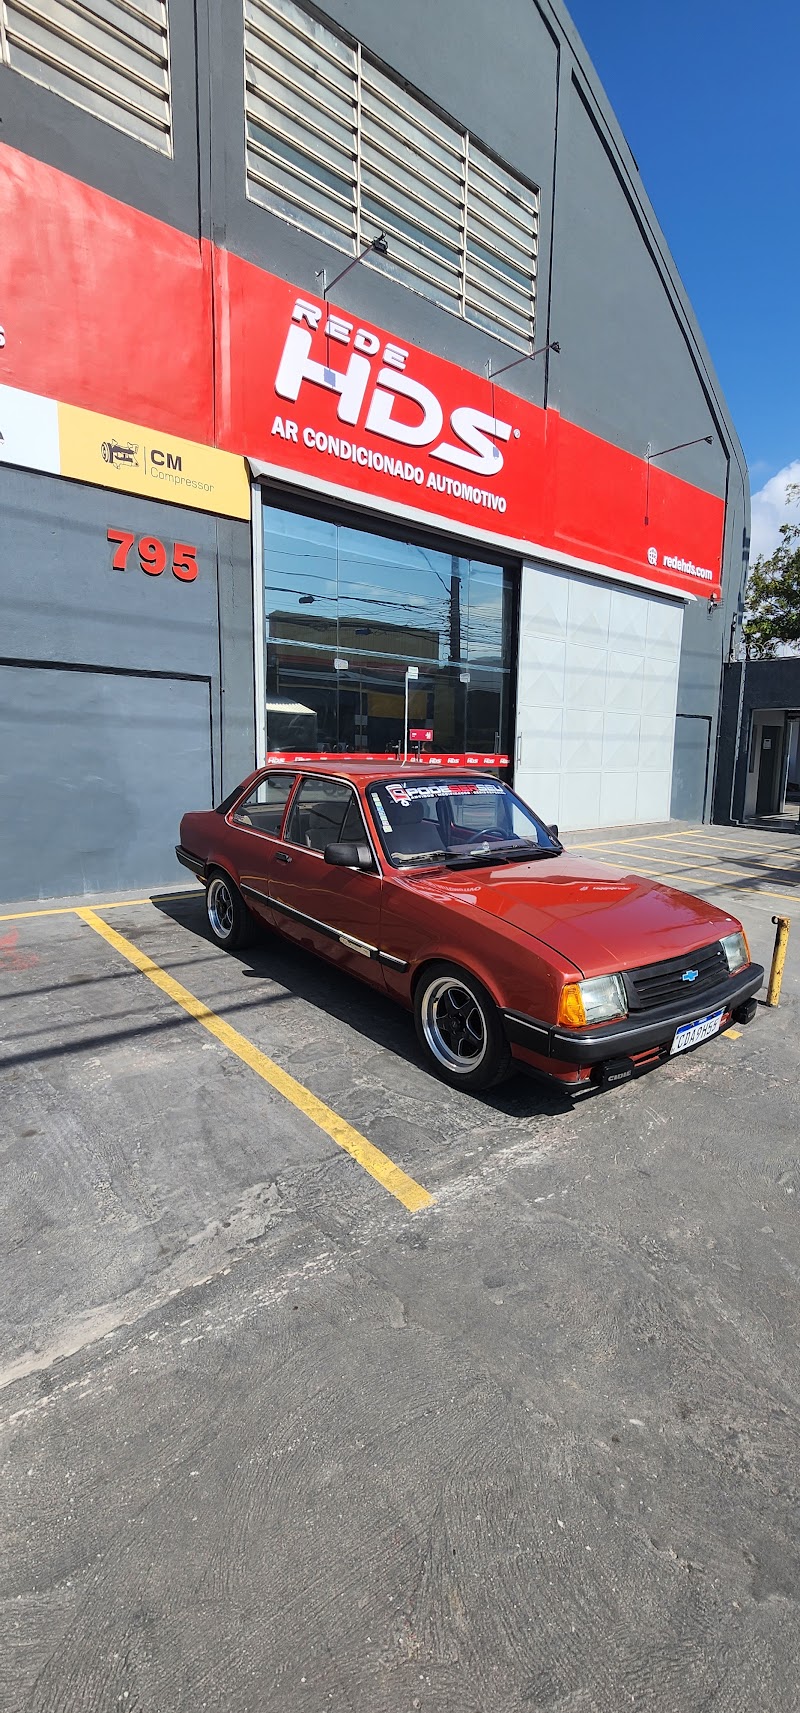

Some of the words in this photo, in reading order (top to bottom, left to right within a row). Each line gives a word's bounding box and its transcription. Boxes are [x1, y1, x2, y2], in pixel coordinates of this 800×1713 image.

[291, 298, 409, 370] REDE
[274, 324, 512, 475] HDS
[150, 449, 182, 471] CM
[150, 467, 214, 492] Compressor
[271, 416, 298, 442] AR
[303, 427, 424, 485] CONDICIONADO
[426, 472, 507, 513] AUTOMOTIVO
[106, 529, 199, 582] 795
[663, 555, 713, 580] redehds.com
